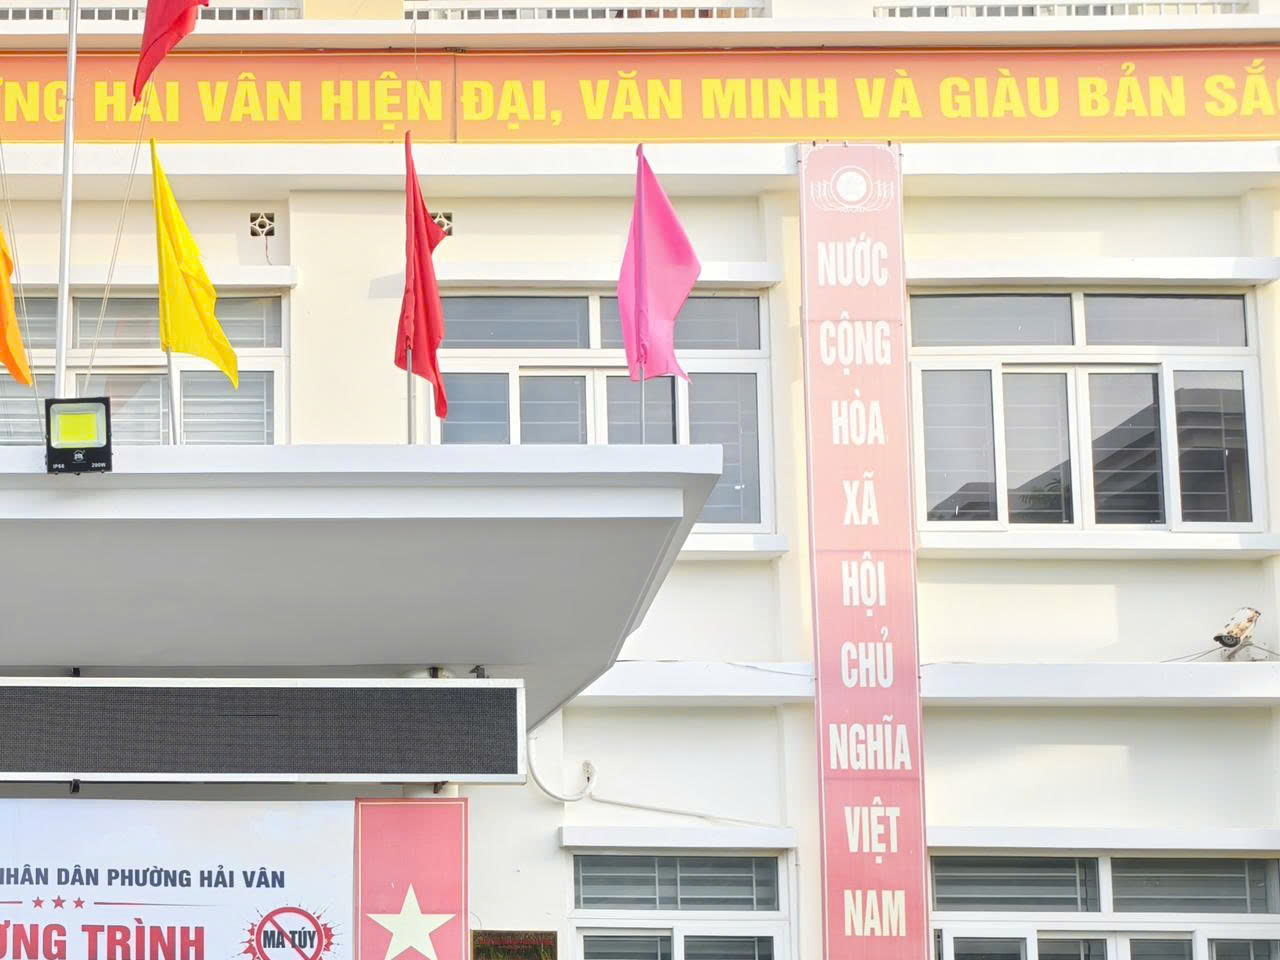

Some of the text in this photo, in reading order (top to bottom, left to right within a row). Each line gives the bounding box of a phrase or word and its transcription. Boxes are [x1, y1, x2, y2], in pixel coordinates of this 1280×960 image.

[197, 72, 302, 122] VÂN
[321, 71, 443, 131] HIỆN
[460, 79, 562, 130] ĐẠI,
[579, 70, 683, 120] VĂN
[701, 78, 839, 120] MINH
[855, 69, 923, 119] VÀ
[938, 68, 1060, 119] GIÀU
[1077, 62, 1186, 119] BẢN
[1203, 56, 1280, 117] SẮ
[817, 232, 889, 287] NƯỚC
[820, 311, 892, 376] CỘNG
[831, 389, 885, 445] HÒA
[842, 471, 880, 526] XÃ
[841, 551, 886, 617] HỘI
[839, 628, 894, 688] CHỦ
[829, 713, 912, 771] NGHĨA
[843, 796, 901, 864] VIỆT
[57, 864, 99, 886] DÂN
[107, 865, 192, 888] PHƯỜNG
[200, 865, 234, 888] HẢI
[242, 866, 285, 888] VÂN
[262, 927, 316, 949] MA TÚY
[843, 889, 906, 938] NAM
